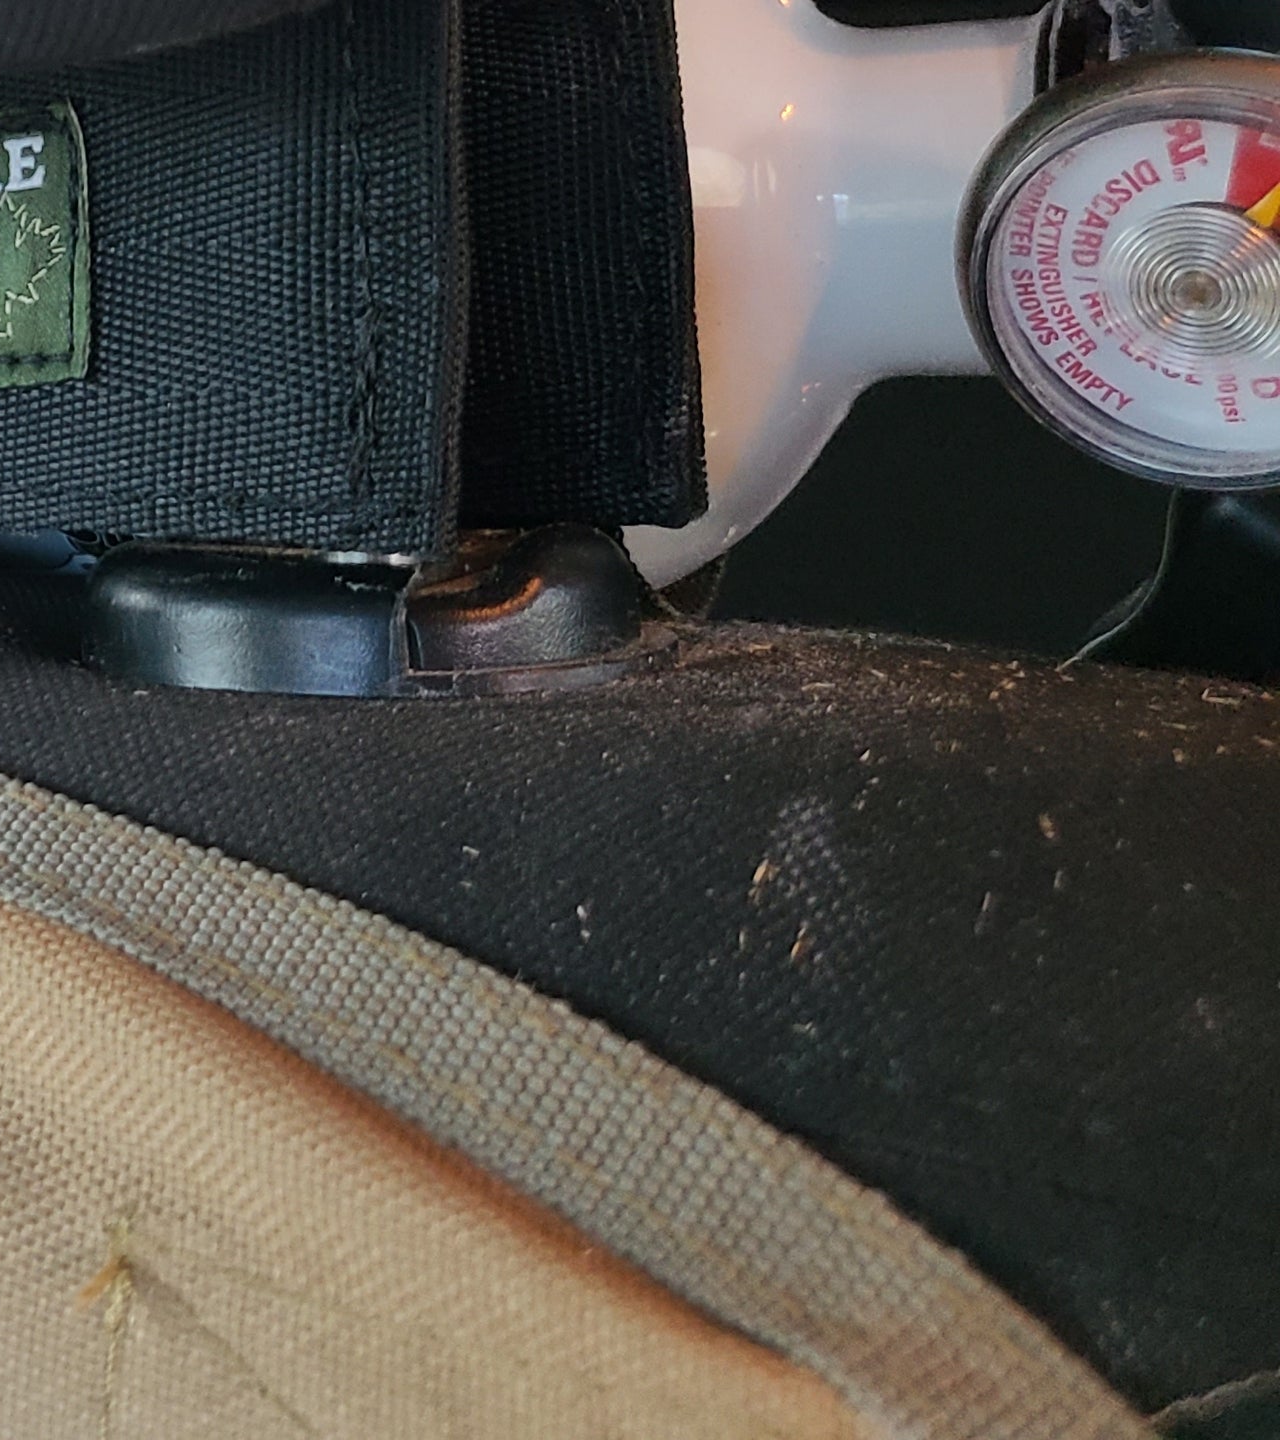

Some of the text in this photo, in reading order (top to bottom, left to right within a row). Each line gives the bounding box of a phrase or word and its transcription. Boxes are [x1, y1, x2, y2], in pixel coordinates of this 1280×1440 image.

[1009, 170, 1055, 257] POINTER
[1072, 159, 1160, 267] DISCARD
[1011, 268, 1059, 346] SHOWS
[1037, 203, 1098, 357] EXTINGUISHER
[1055, 351, 1134, 411] EMPTY
[1214, 396, 1246, 422] psi
